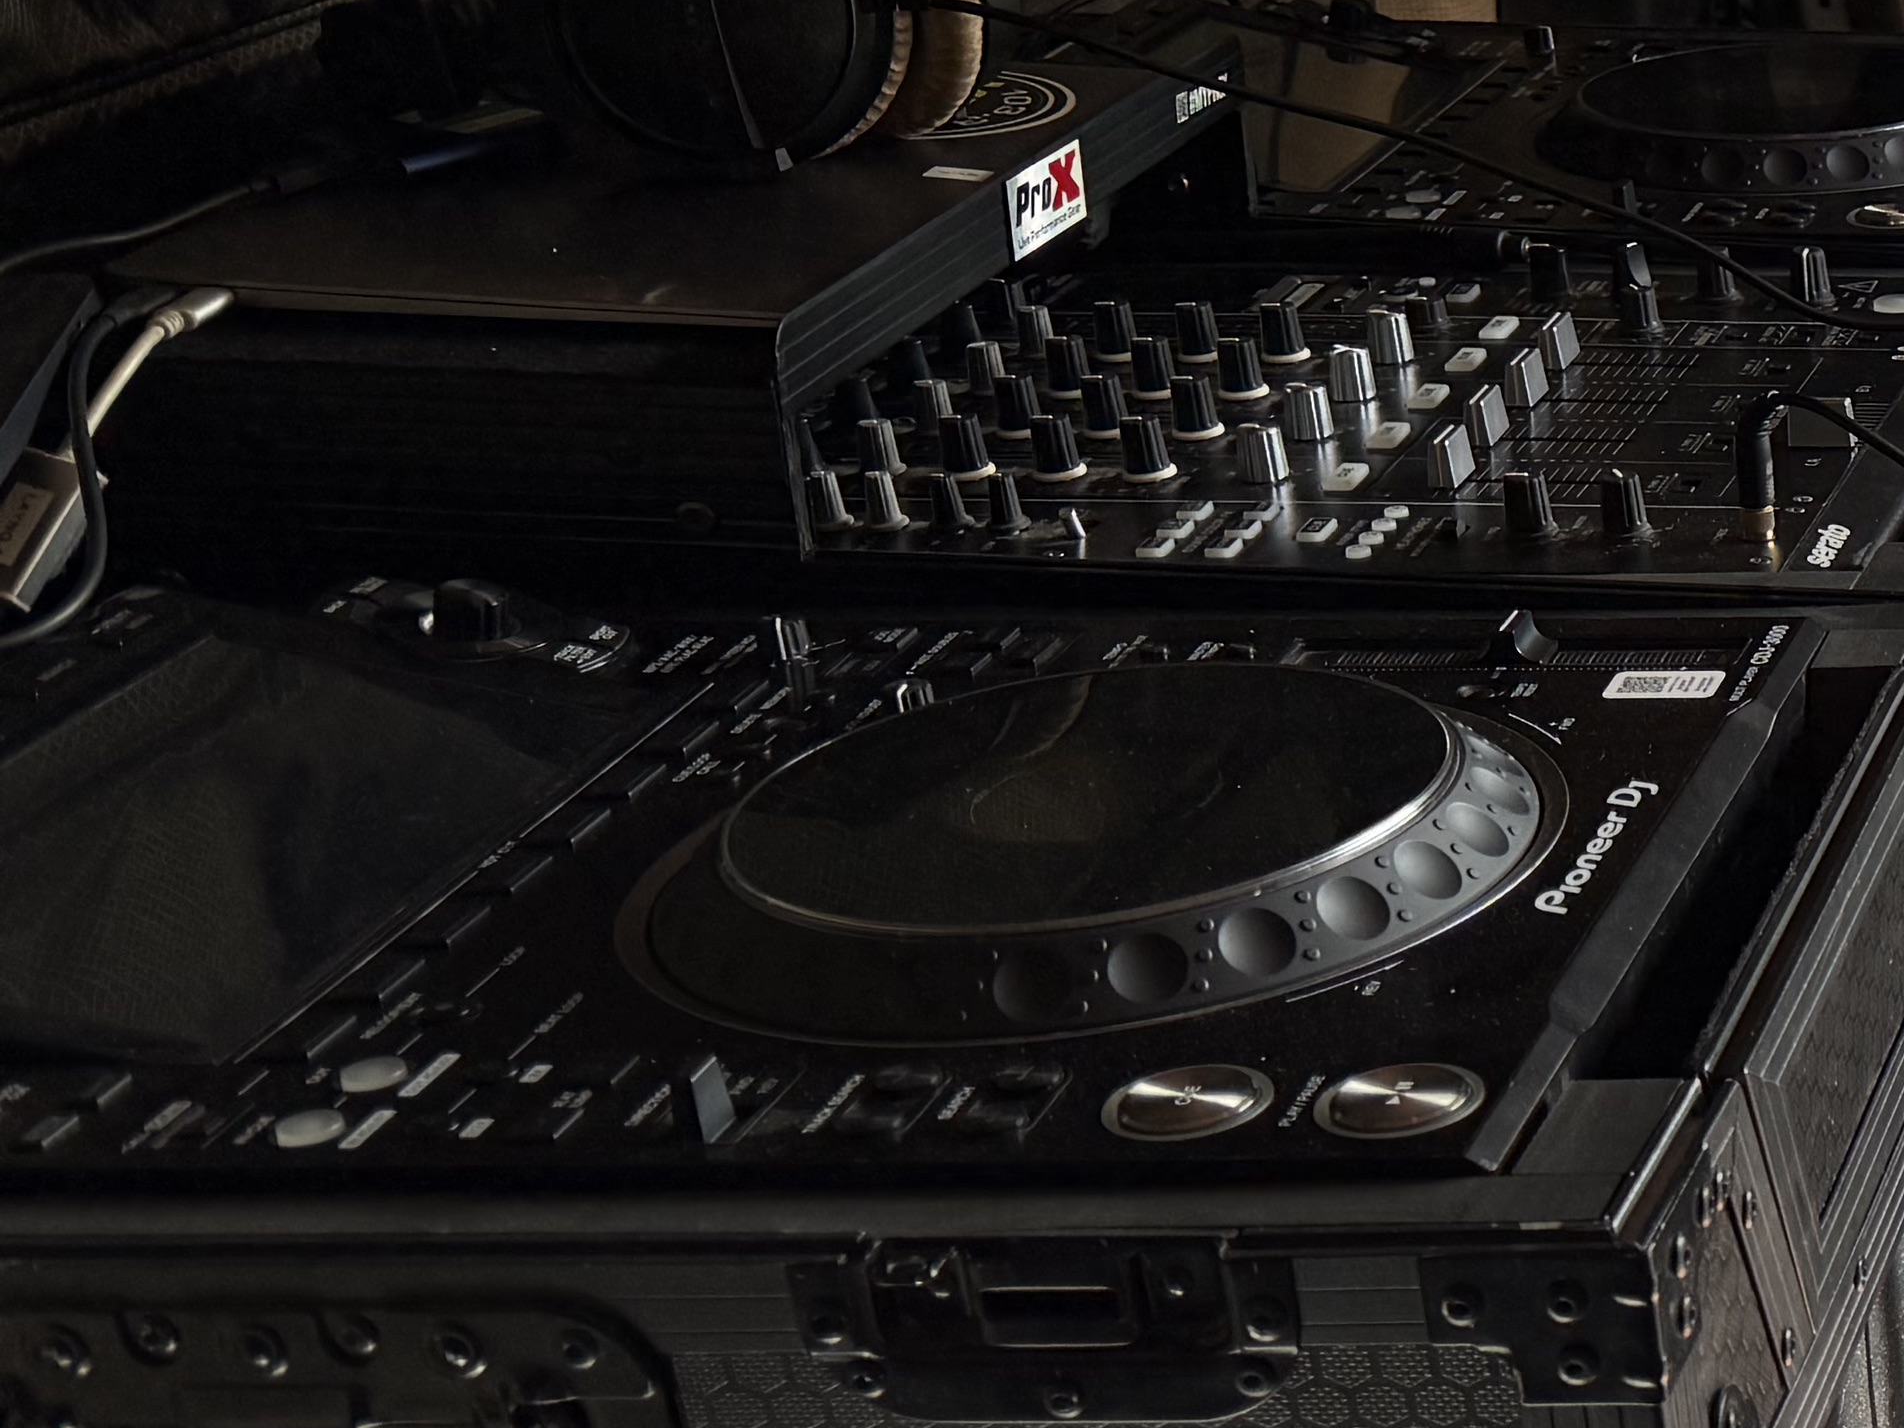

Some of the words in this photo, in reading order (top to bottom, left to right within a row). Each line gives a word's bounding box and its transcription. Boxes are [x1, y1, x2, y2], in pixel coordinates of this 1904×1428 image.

[1016, 149, 1080, 228] ProX
[1806, 523, 1851, 569] serato
[1534, 810, 1628, 915] Pioneer
